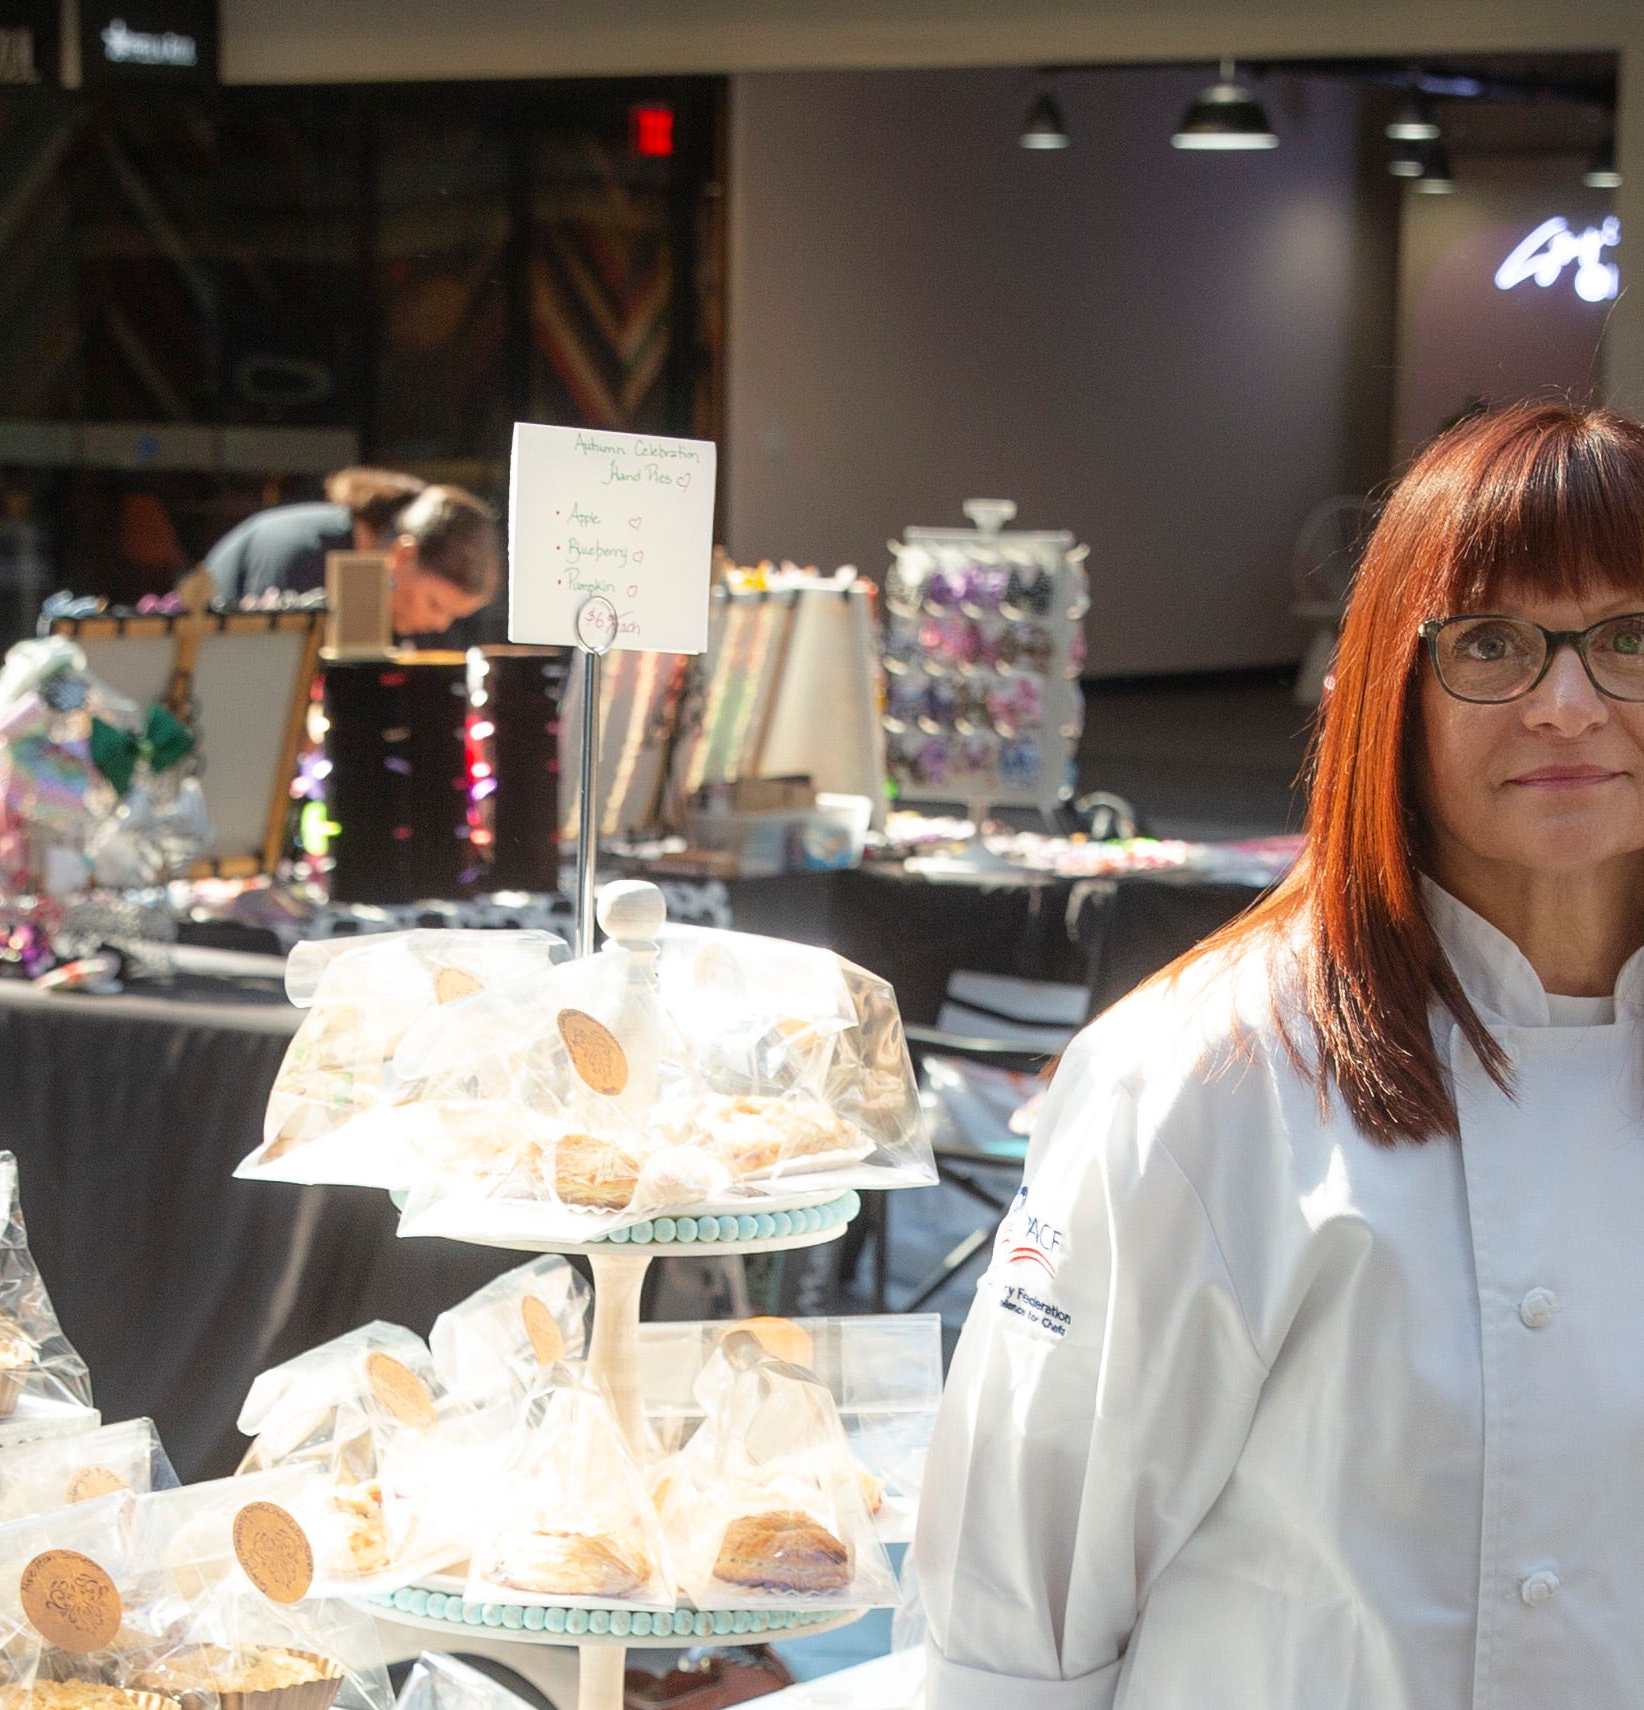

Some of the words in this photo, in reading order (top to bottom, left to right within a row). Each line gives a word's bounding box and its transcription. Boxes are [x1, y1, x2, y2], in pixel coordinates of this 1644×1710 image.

[567, 502, 601, 528] Apple
[563, 567, 616, 600] Pumpkin
[1017, 1287, 1072, 1325] Federation
